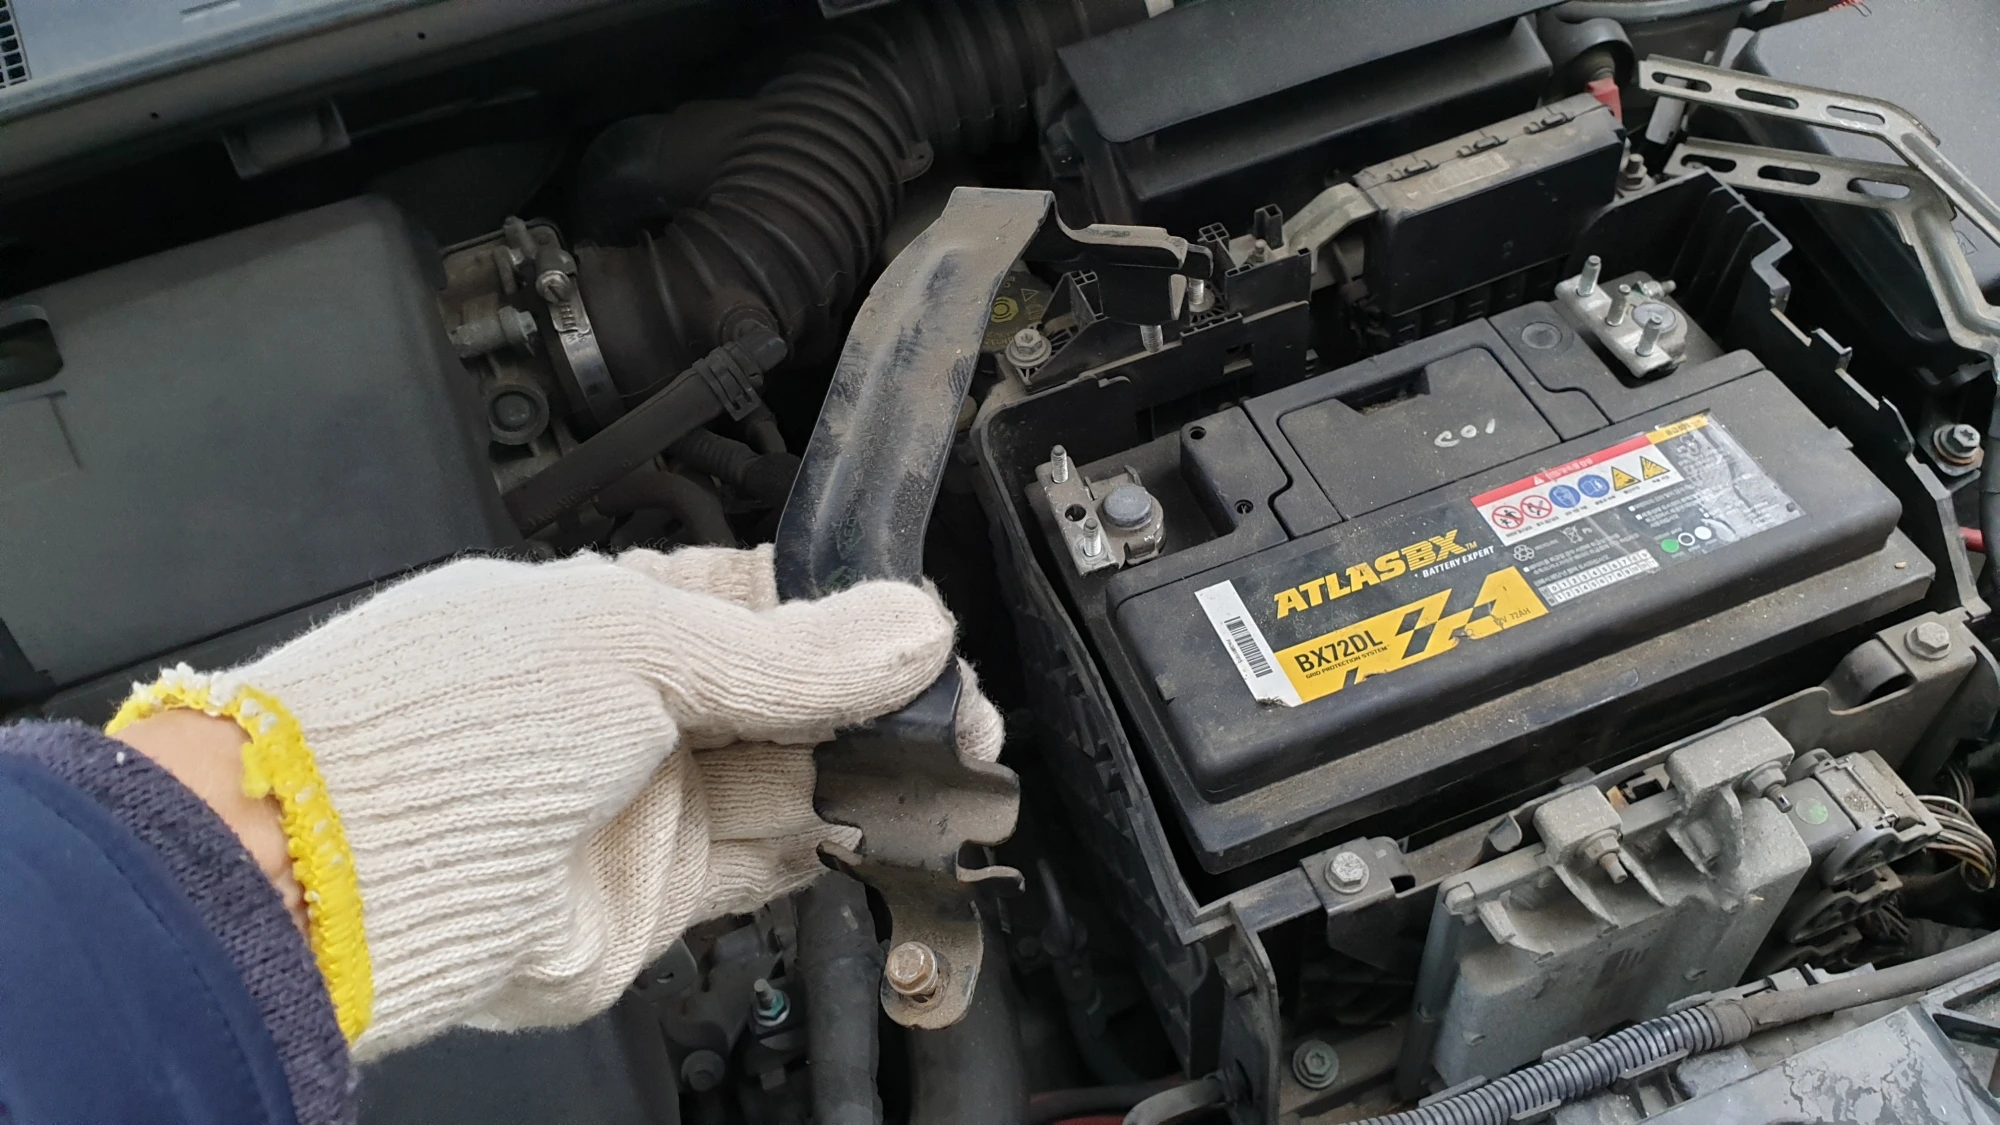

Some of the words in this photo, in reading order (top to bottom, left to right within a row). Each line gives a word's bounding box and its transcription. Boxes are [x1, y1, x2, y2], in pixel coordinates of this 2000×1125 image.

[1422, 557, 1461, 578] BATTERY
[1461, 545, 1495, 564] EXPERT
[1508, 607, 1532, 620] 72AH
[1294, 630, 1384, 673] BX72DL
[1321, 655, 1361, 673] PROTECTION
